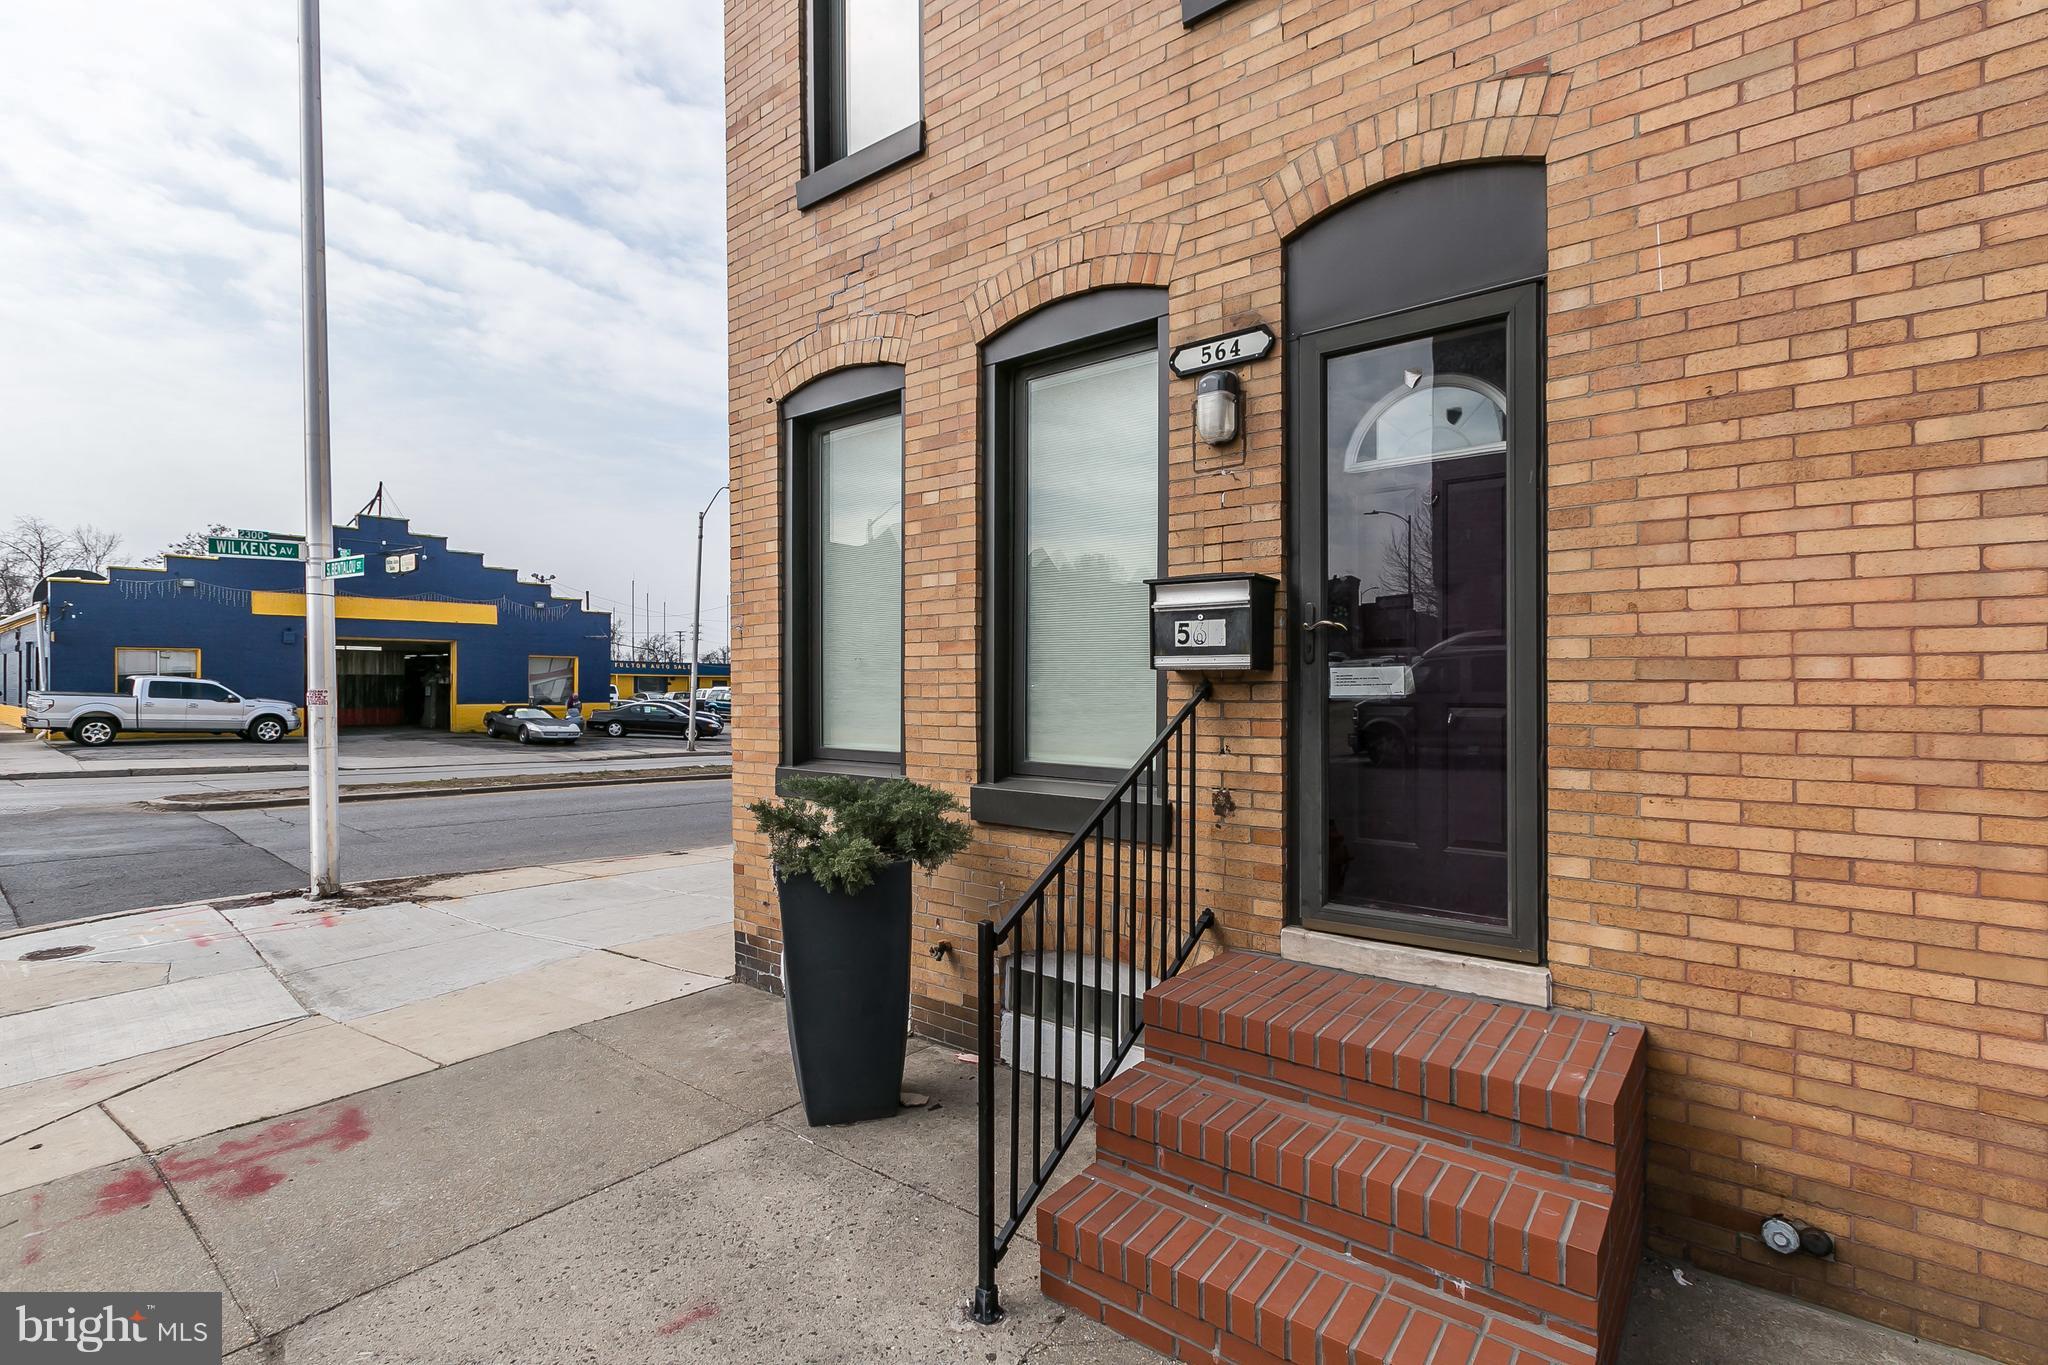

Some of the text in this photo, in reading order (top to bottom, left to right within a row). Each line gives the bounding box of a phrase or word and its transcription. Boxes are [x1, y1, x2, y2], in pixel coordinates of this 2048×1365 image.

[1201, 339, 1240, 364] 564
[239, 530, 264, 540] 2300
[216, 540, 277, 556] WILKENS
[332, 559, 356, 575] BENTALOU
